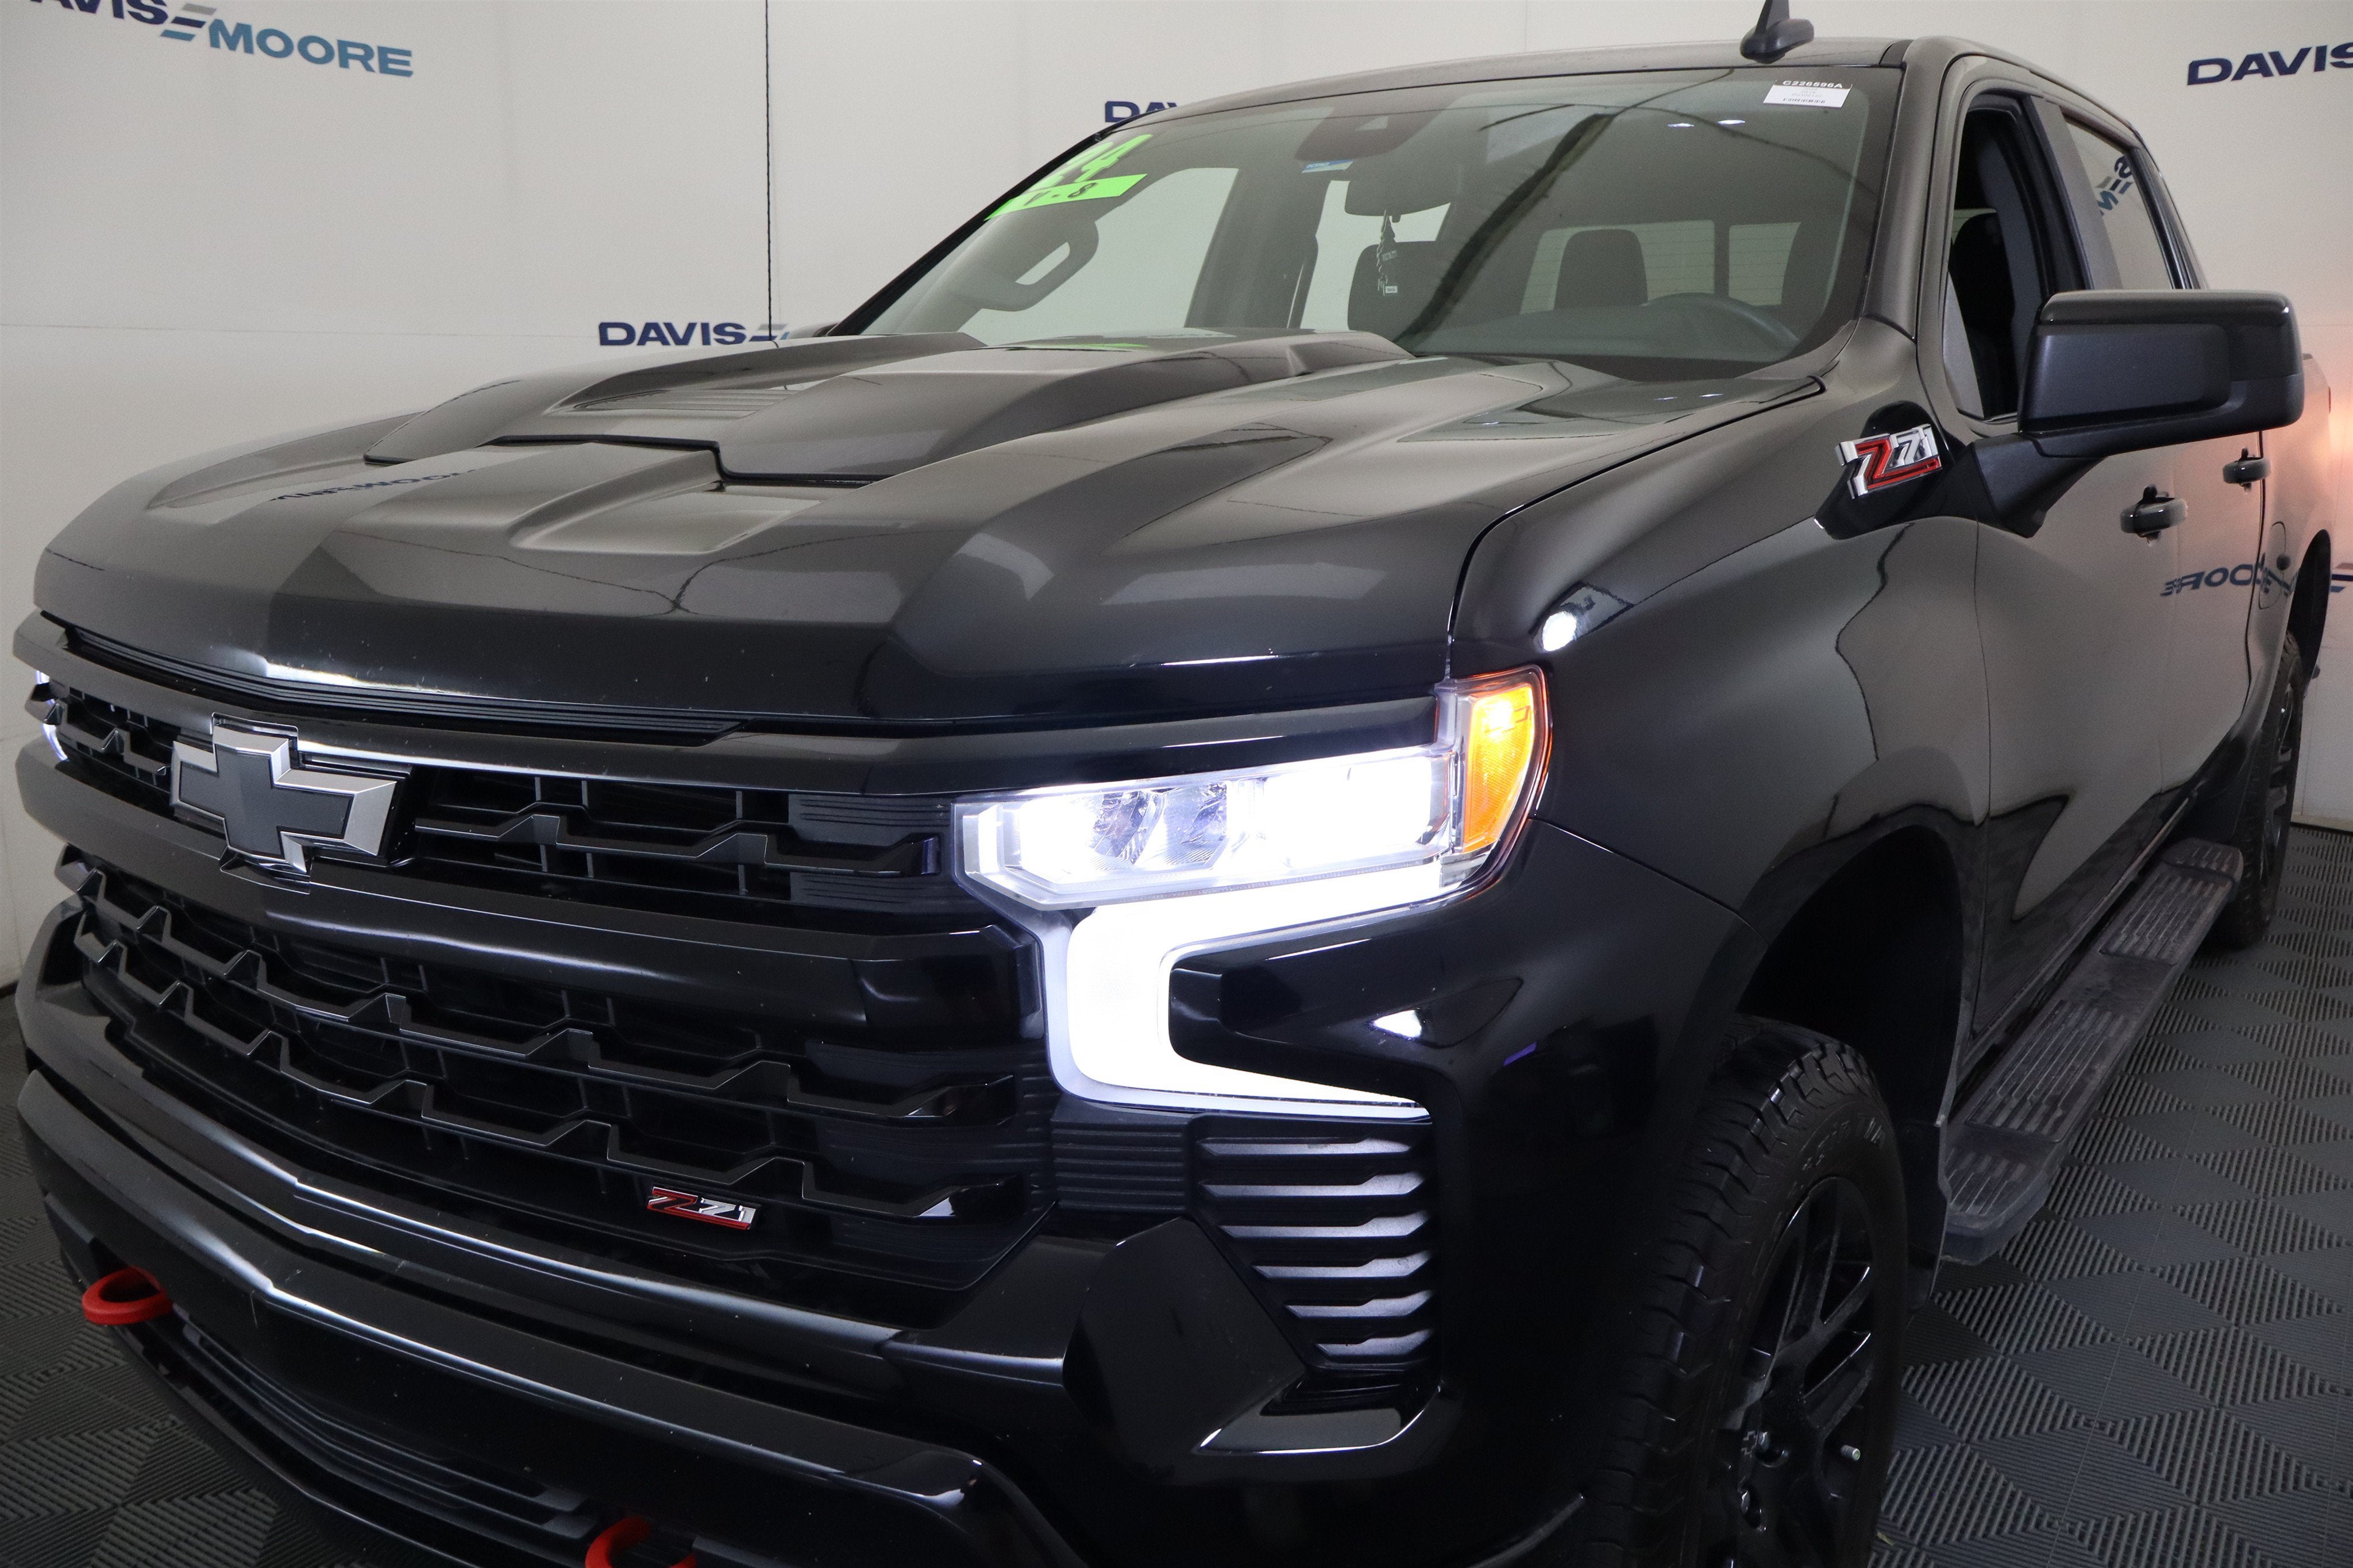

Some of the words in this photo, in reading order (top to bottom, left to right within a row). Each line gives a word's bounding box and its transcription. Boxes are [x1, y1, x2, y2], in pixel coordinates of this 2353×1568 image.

[208, 19, 413, 77] MOORE
[599, 322, 747, 346] DAVIS
[1835, 424, 1942, 499] Z71
[646, 1186, 757, 1230] Z71
